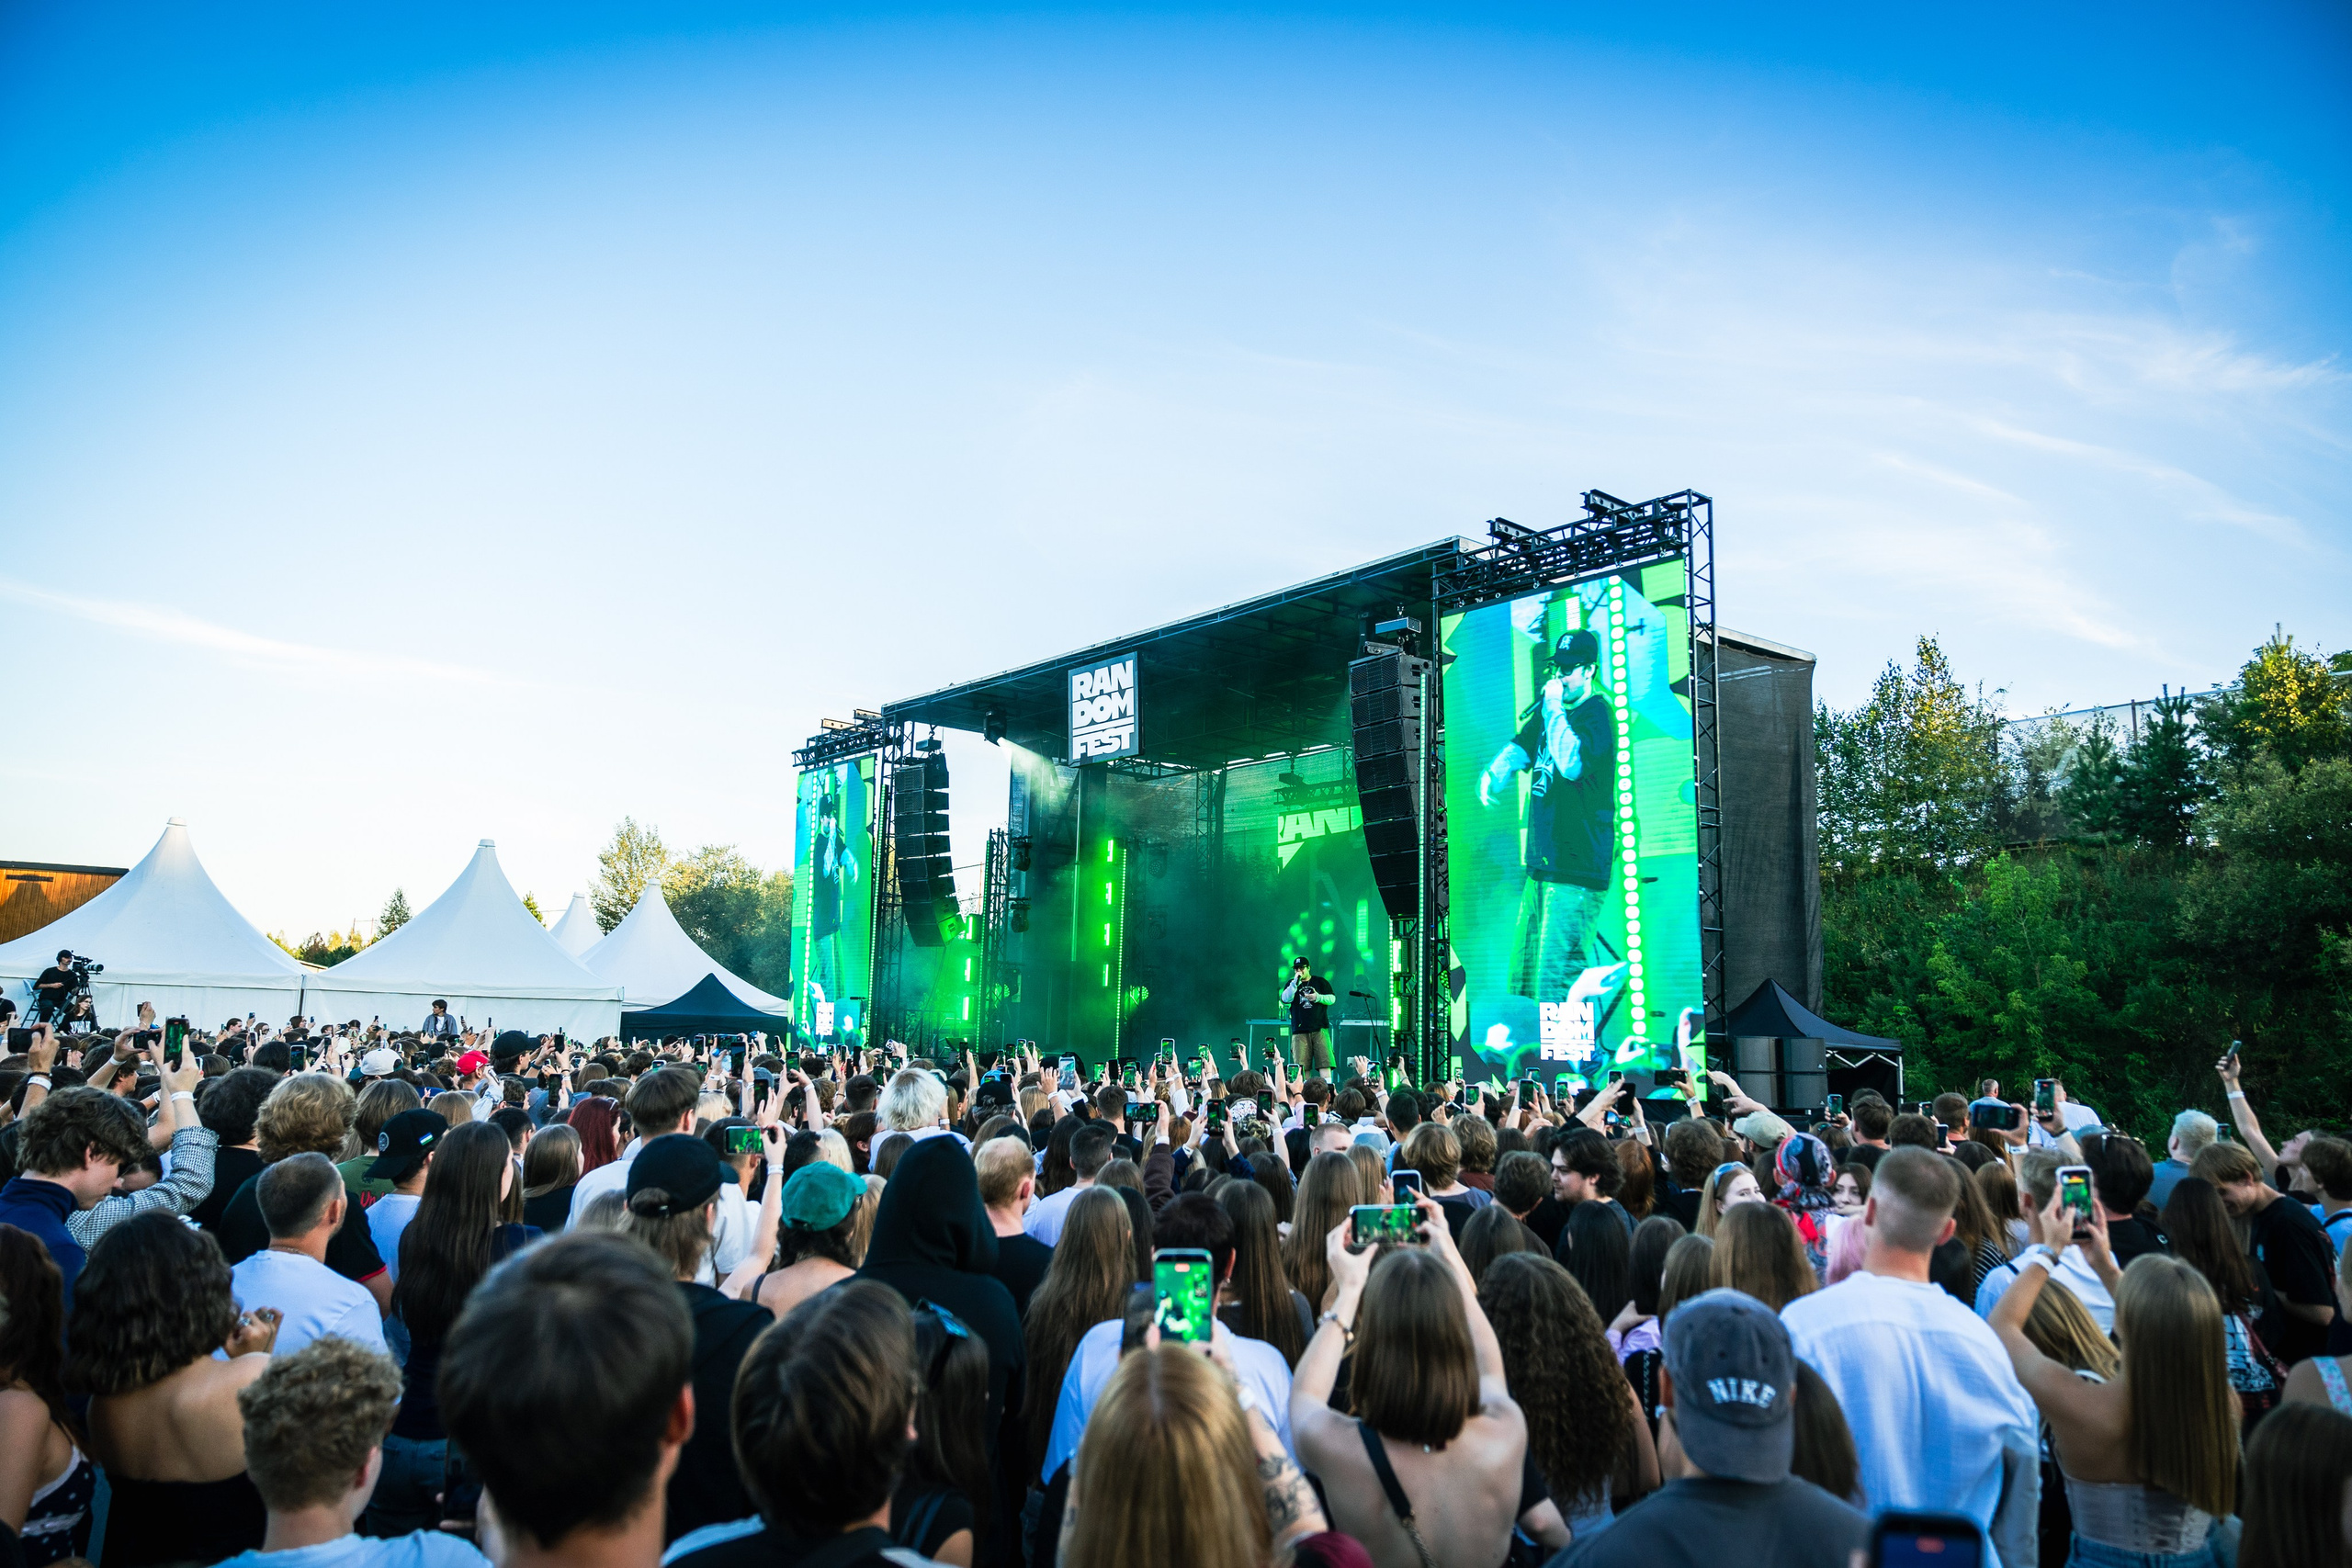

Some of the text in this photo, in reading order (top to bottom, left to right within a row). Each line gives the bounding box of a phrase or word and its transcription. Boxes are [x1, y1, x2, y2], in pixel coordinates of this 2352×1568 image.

[1072, 660, 1134, 702] RAN
[1072, 688, 1135, 729] DOM
[1072, 724, 1135, 761] FEST
[1540, 1021, 1595, 1039] DOM
[1541, 1043, 1595, 1061] FEST
[1707, 1377, 1776, 1408] NIKE
